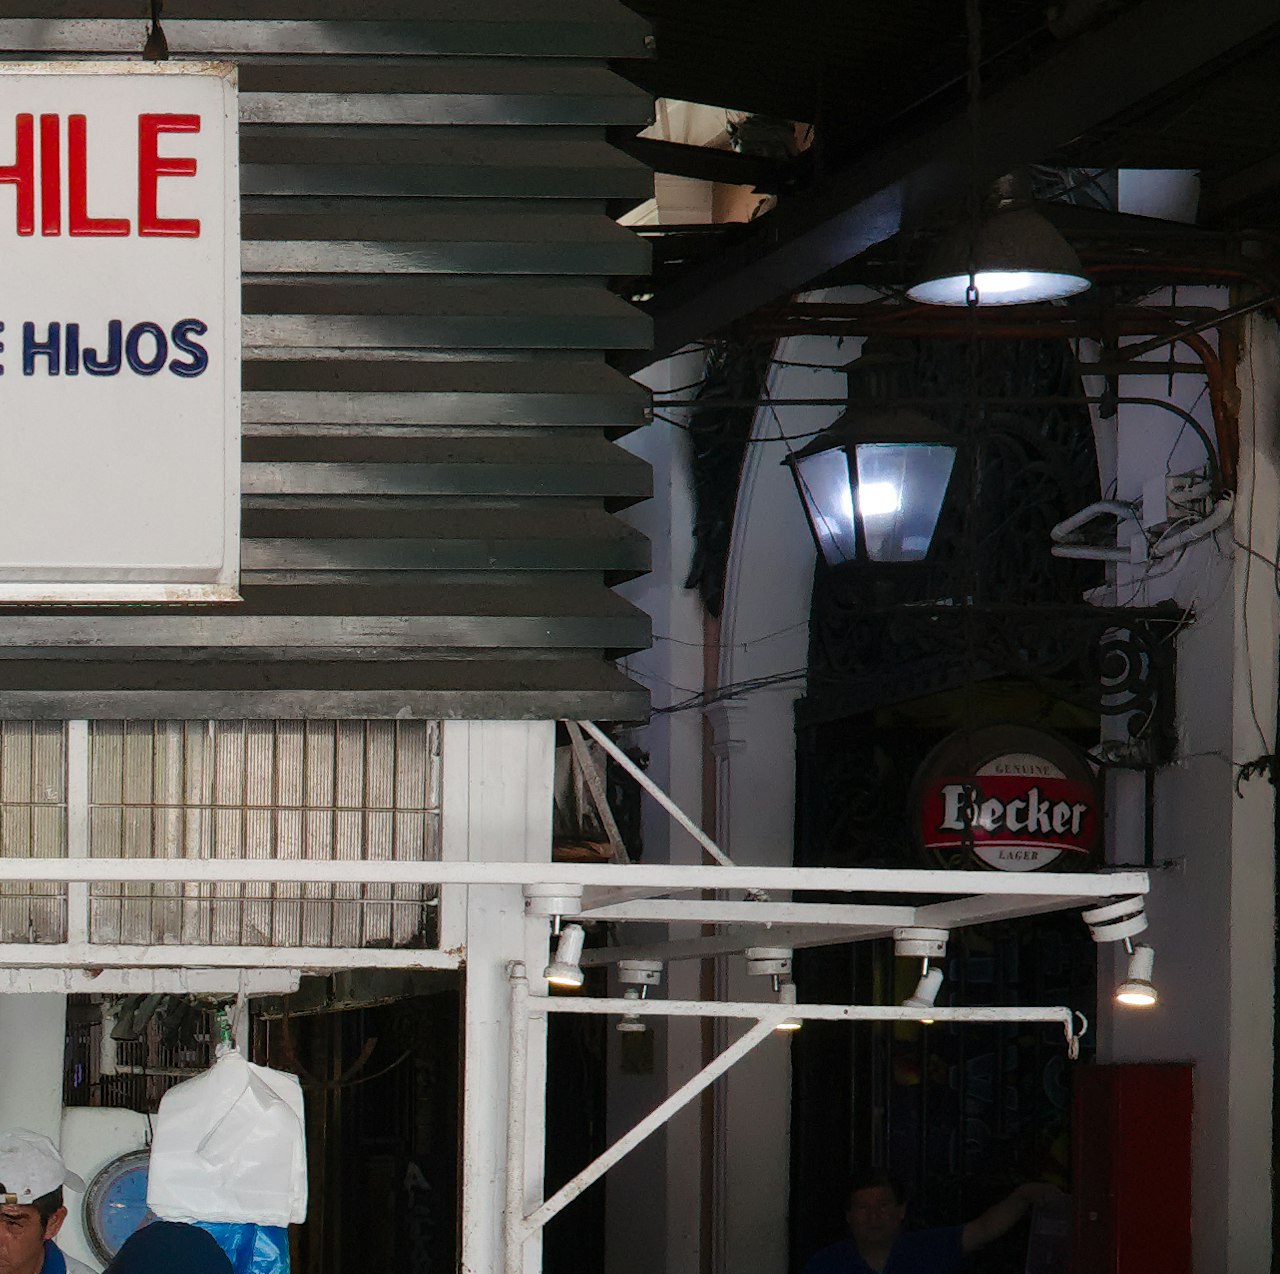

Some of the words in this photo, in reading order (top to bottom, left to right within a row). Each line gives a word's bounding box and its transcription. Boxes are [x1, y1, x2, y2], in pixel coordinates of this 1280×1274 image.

[22, 319, 210, 378] HIJOS
[939, 784, 1088, 835] Becker
[999, 849, 1039, 861] LAGER
